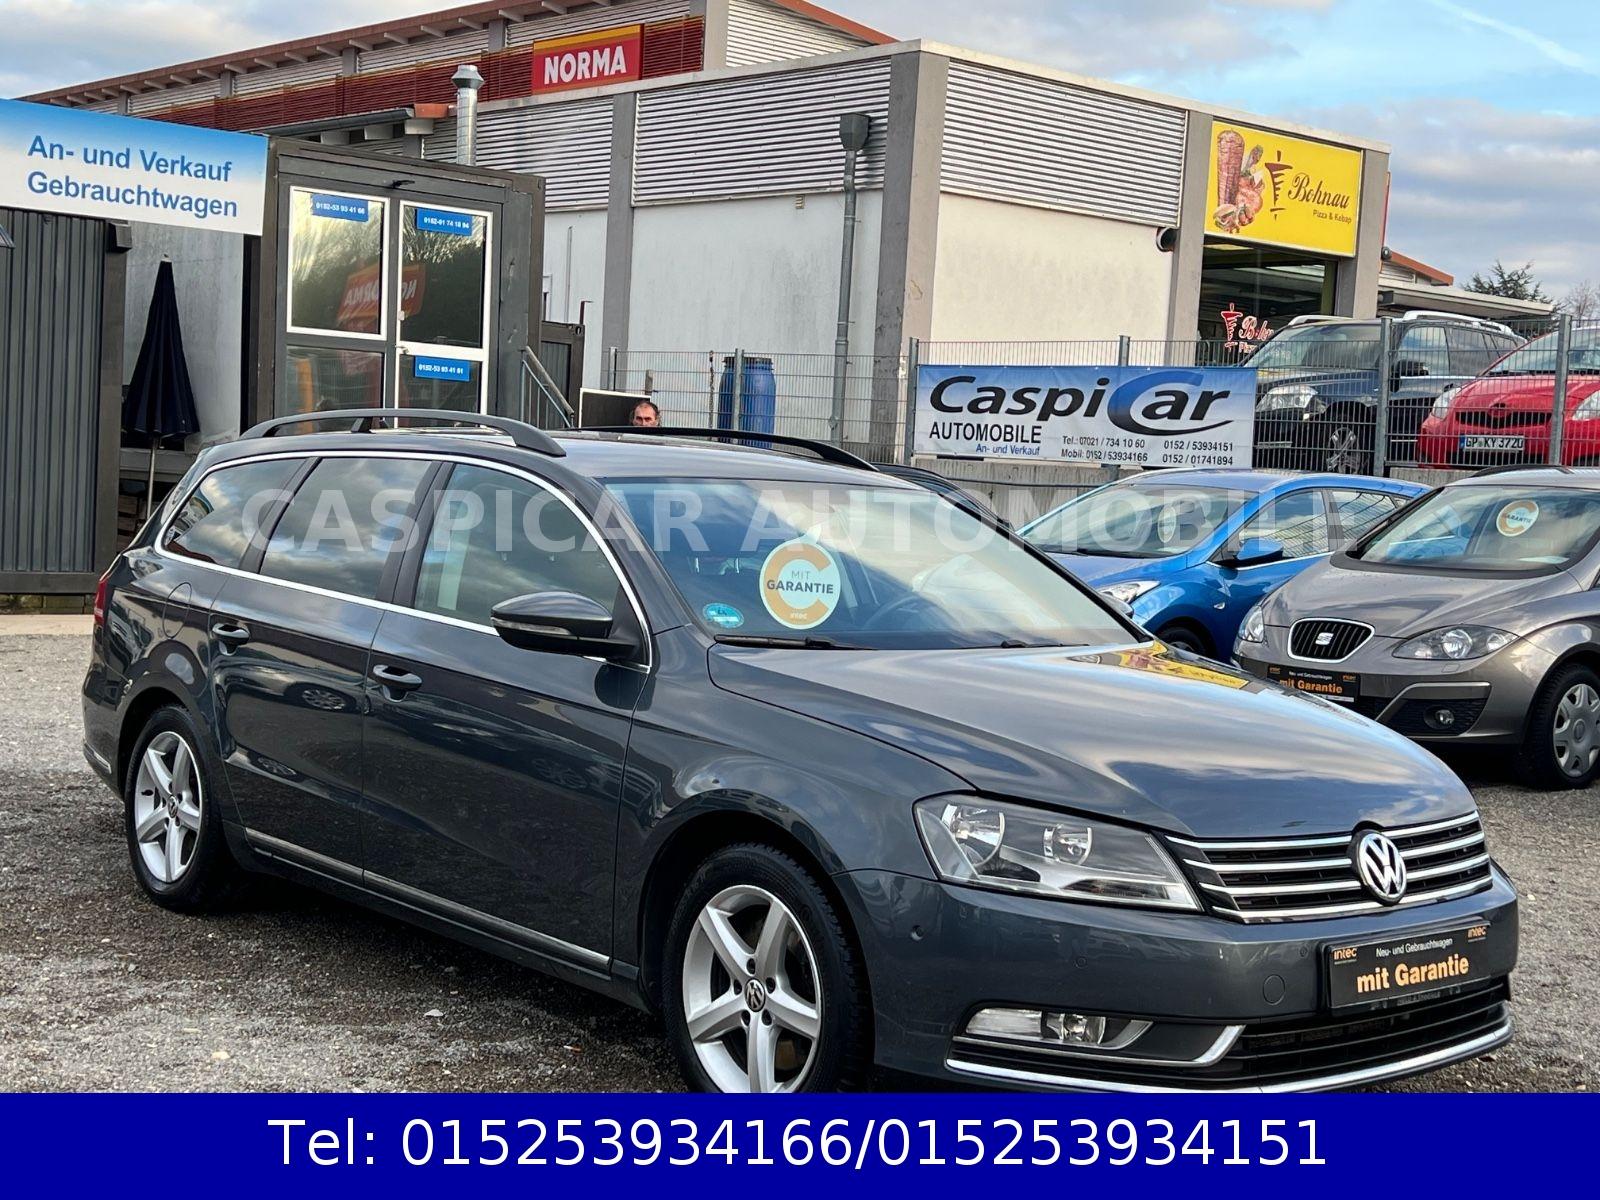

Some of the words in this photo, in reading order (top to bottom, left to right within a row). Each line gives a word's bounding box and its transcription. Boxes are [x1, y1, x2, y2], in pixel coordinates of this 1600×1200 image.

[544, 45, 627, 85] NORMA
[28, 135, 74, 160] An-
[83, 148, 130, 169] und
[139, 149, 232, 182] Verkauf
[27, 171, 237, 219] Gebrauchtwagen
[1287, 172, 1350, 209] Bohnau
[1313, 209, 1327, 219] Pizza
[1329, 212, 1333, 220] &
[929, 421, 1043, 444] AUTOMOBILE
[976, 443, 990, 453] An-
[992, 445, 1008, 455] und
[1010, 445, 1041, 456] Verkauf
[1079, 436, 1099, 447] 07021
[1105, 437, 1120, 447] 734
[1122, 439, 1133, 448] 10
[1134, 439, 1146, 449] 60
[1163, 440, 1185, 450] 0152
[1191, 441, 1234, 452] 53934151
[1466, 436, 1478, 448] GP
[1484, 437, 1497, 448] KY
[1498, 437, 1524, 449] 3720
[1061, 448, 1084, 459] Mobil:
[1085, 449, 1102, 460] 0152
[1107, 451, 1149, 462] 53934166
[1162, 453, 1184, 464] 0152
[1190, 454, 1234, 466] 01741894
[791, 569, 811, 579] MIT
[766, 579, 834, 594] GARANTIE
[1297, 680, 1343, 694] Garantie
[1375, 947, 1391, 958] Neu-
[1392, 944, 1404, 955] und
[1405, 937, 1453, 953] Gebrauchtwagen
[1357, 966, 1390, 993] mit
[1394, 953, 1470, 987] Garantie
